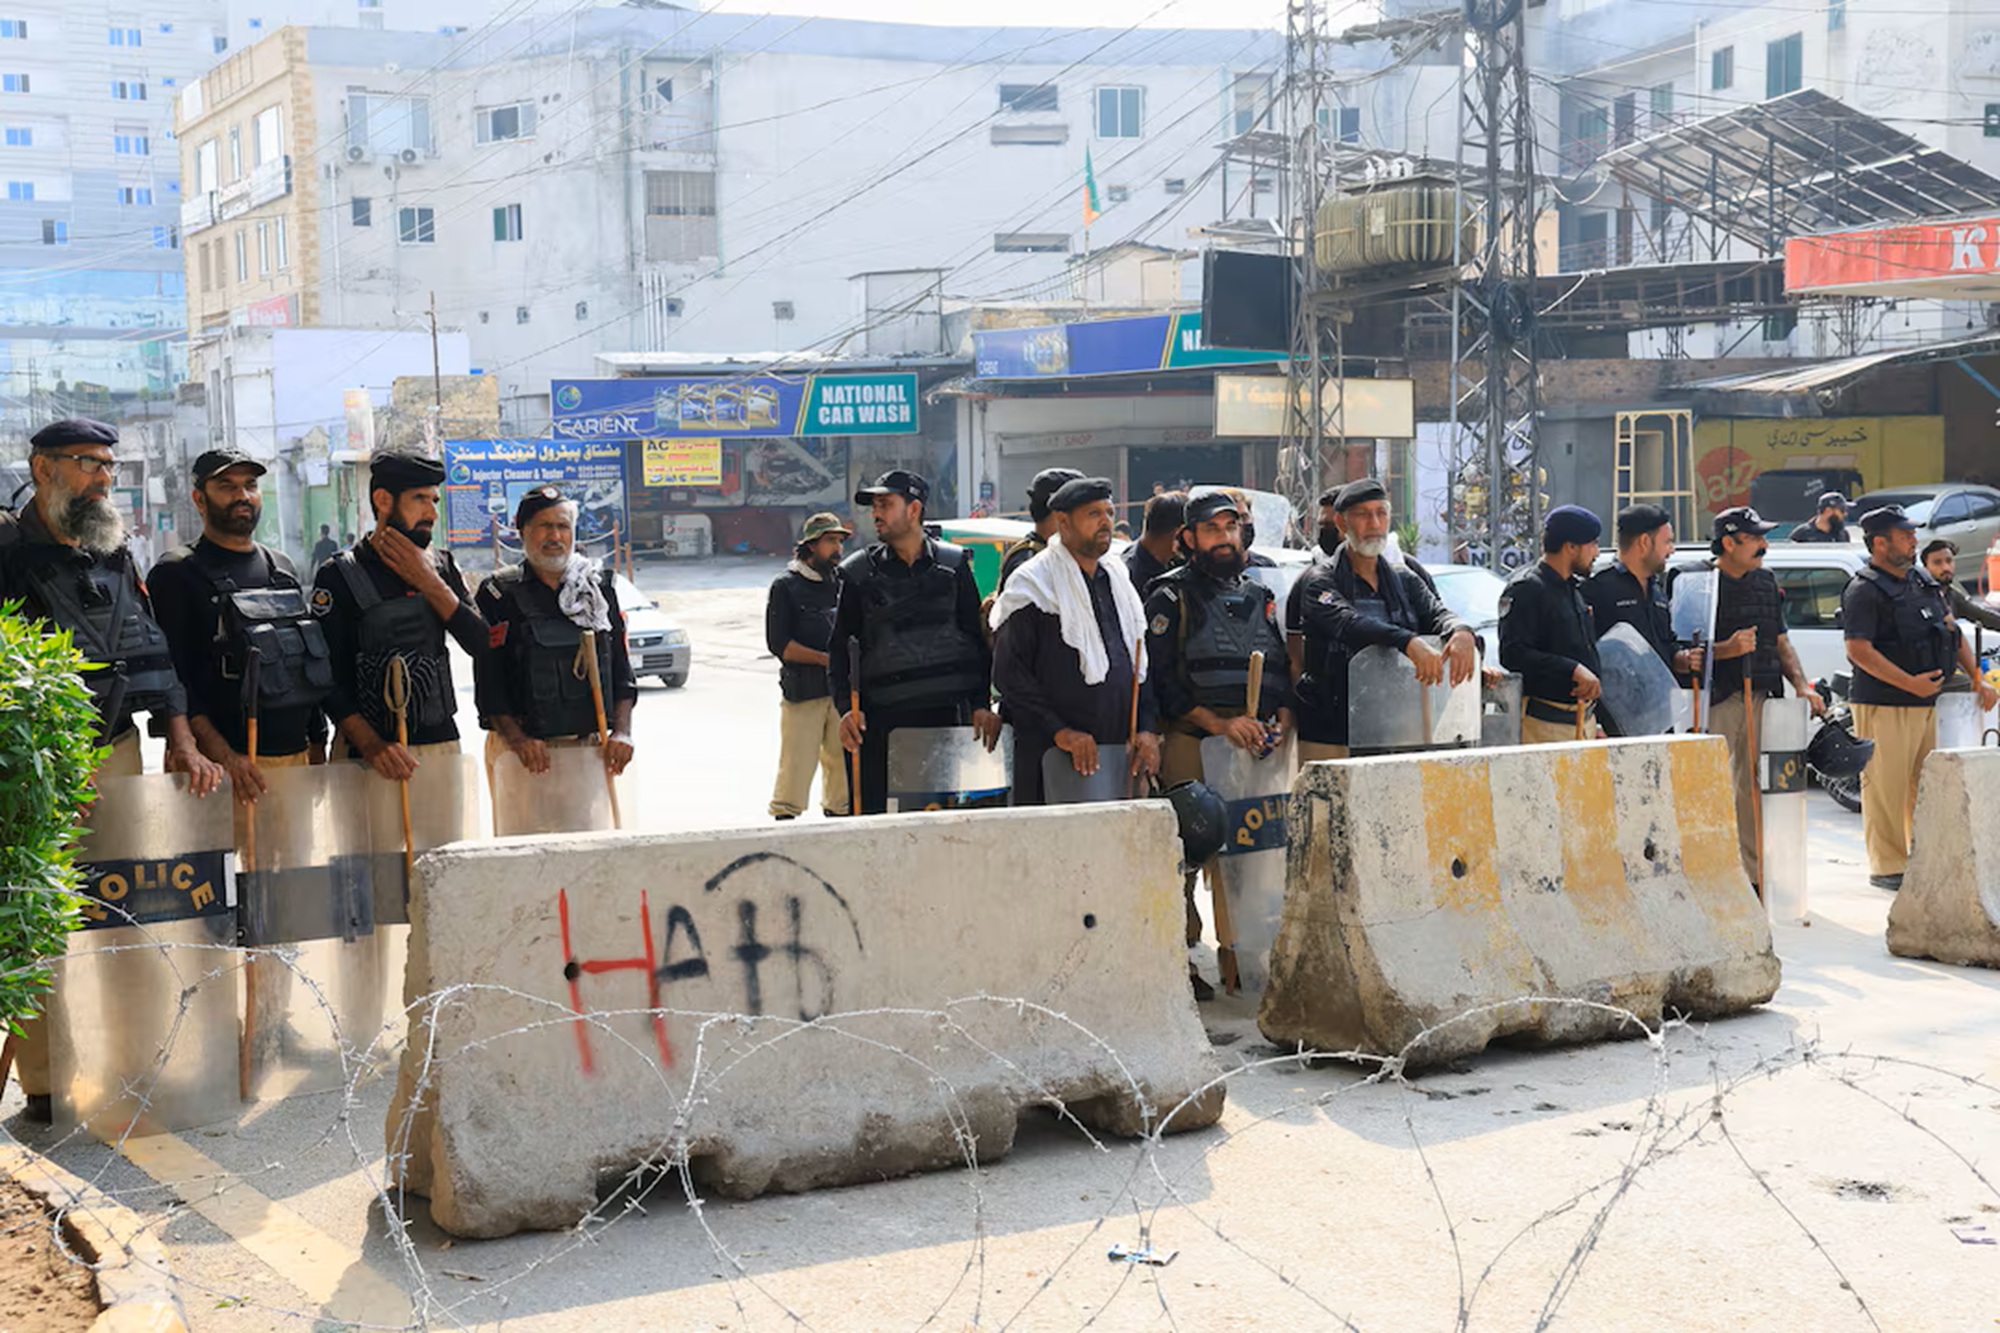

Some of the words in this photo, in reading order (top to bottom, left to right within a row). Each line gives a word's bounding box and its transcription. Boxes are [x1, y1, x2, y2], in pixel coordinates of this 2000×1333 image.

[1950, 226, 2000, 271] K
[821, 384, 907, 405] NATIONAL
[818, 406, 855, 426] CAR
[857, 403, 911, 424] WASH
[646, 440, 670, 452] AC
[1236, 799, 1281, 846] POLI
